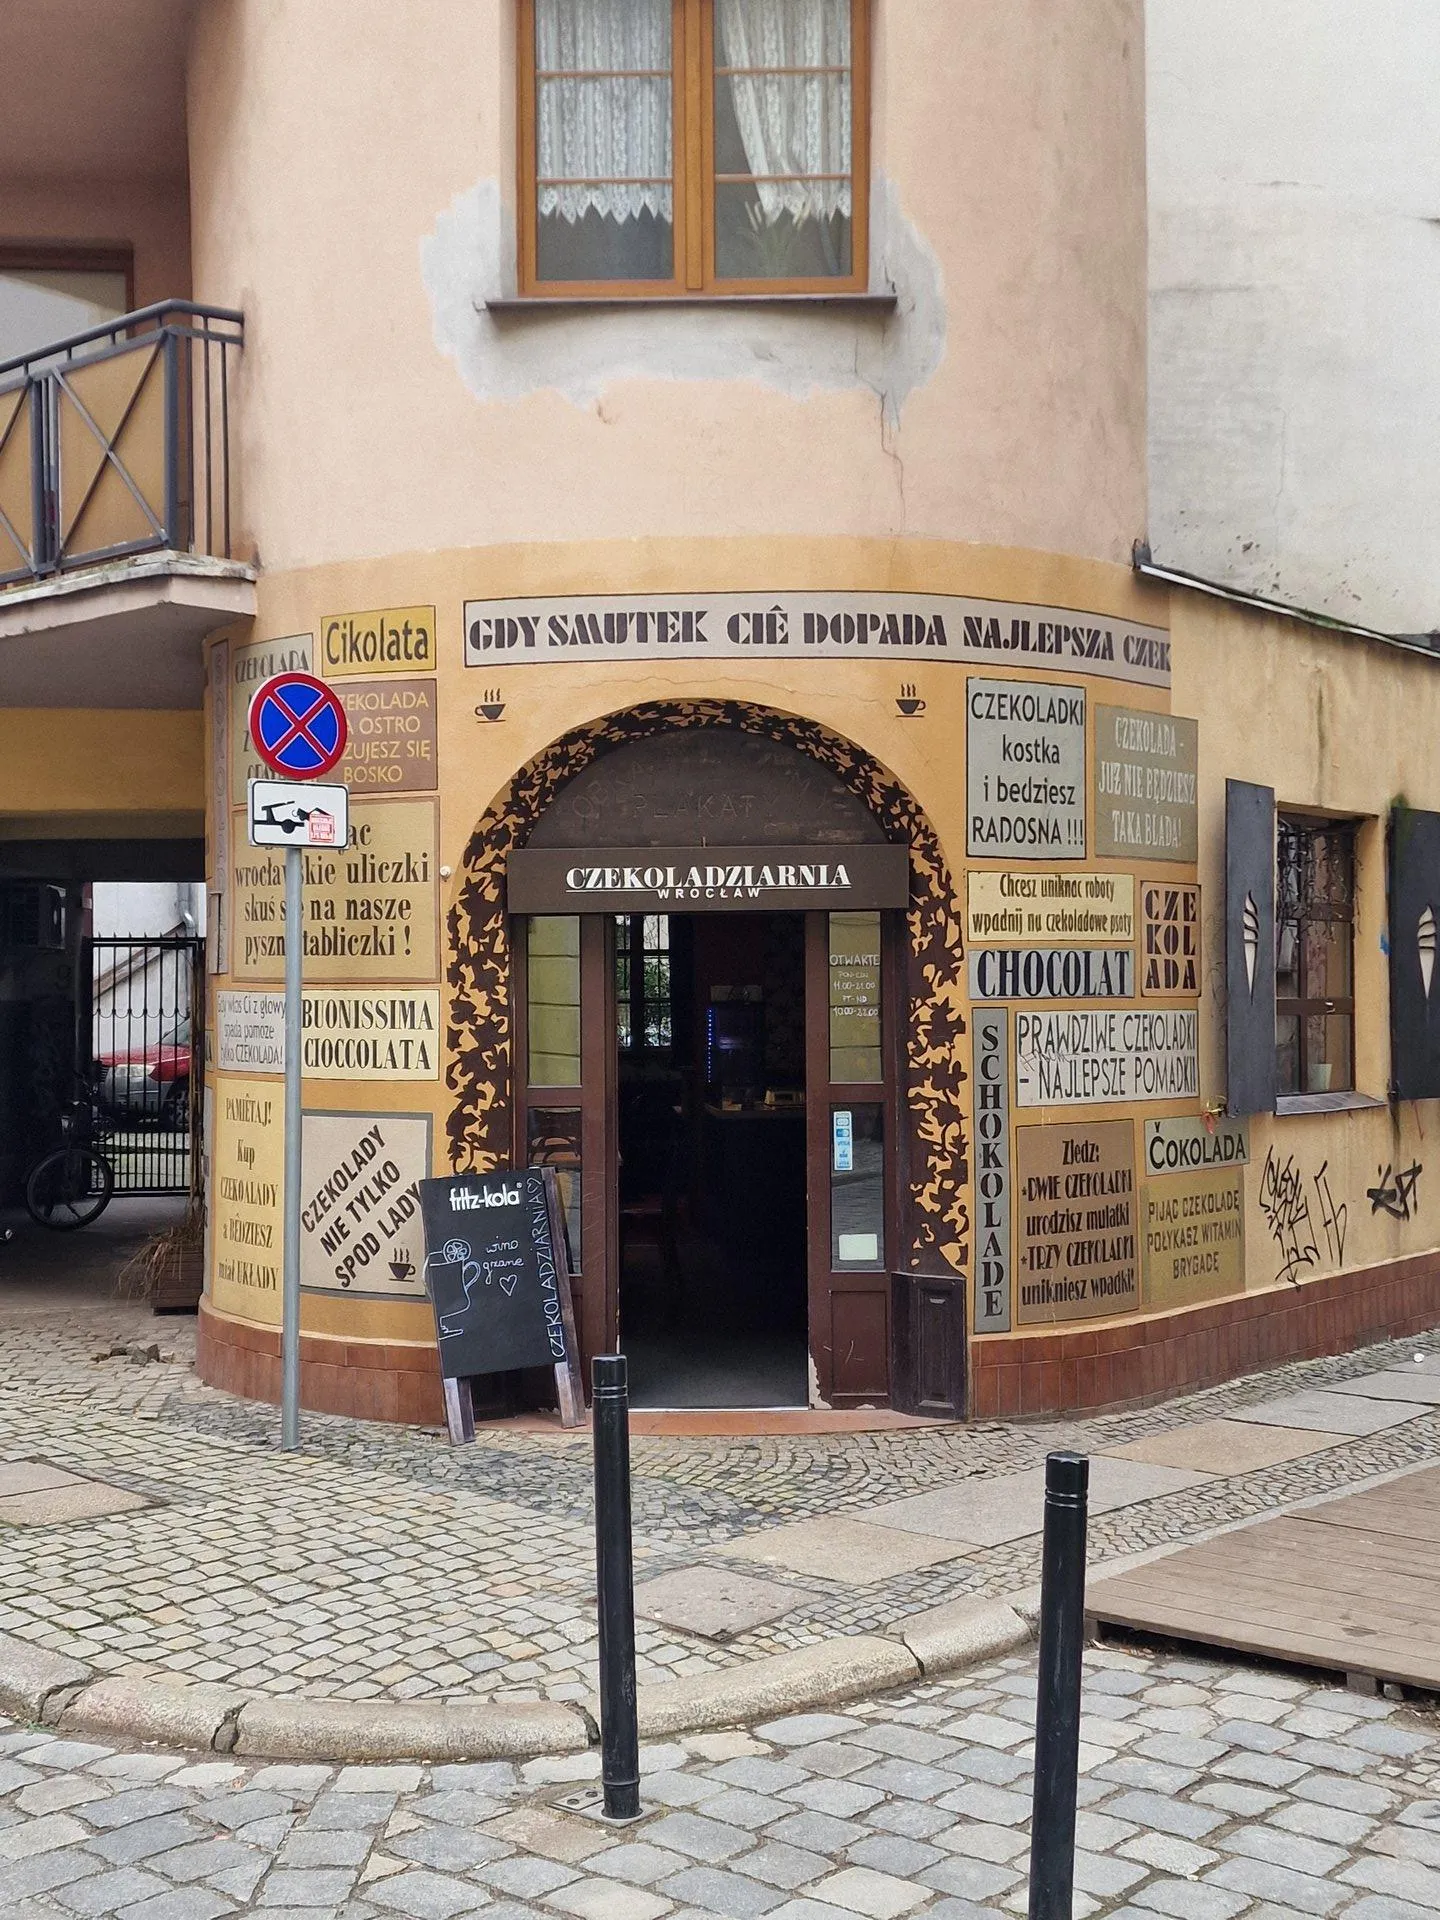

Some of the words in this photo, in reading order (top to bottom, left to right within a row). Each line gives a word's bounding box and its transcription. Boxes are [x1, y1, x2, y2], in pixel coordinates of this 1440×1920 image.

[326, 619, 429, 664] Cikolata
[470, 617, 540, 650] GDY
[548, 611, 708, 646] SMUTEK
[803, 613, 947, 646] DOPADA
[963, 616, 1114, 661] NAJLEPSZA
[1123, 635, 1171, 672] CZEK
[971, 692, 1084, 726] CZEKOLADKI
[359, 716, 420, 735] OSTRO
[1115, 717, 1176, 757] CZEKOLADA
[342, 741, 401, 764] ZUJESZ
[406, 740, 431, 761] SIĘ
[1002, 734, 1061, 765] kostka
[343, 765, 403, 783] BOSKO
[983, 775, 989, 802] i
[1124, 763, 1143, 798] NIE
[1146, 768, 1196, 804] BĘDZIESZ
[972, 816, 1062, 844] RADOSNA
[1112, 810, 1142, 844] TAKA
[346, 852, 429, 884] uliczki
[566, 864, 851, 889] CZEKOLADZIARNIA
[657, 887, 761, 900] WROCŁAW
[1000, 873, 1037, 898] Chcesz
[1085, 876, 1115, 903] roboty
[244, 893, 276, 922] skuś
[310, 898, 336, 921] na
[346, 898, 412, 921] nasze
[1145, 890, 1196, 921] CZE
[972, 908, 1023, 935] wpadnij
[1046, 908, 1108, 932] czekoladowe
[245, 935, 287, 965] pyszn
[303, 926, 395, 956] tabliczki
[1146, 924, 1195, 955] KOL
[830, 954, 880, 966] OTWARTE
[977, 950, 1130, 997] CHOCOLAT
[1145, 959, 1196, 990] ADA
[302, 999, 434, 1030] BUONISSIMA
[1018, 1014, 1116, 1054] PRAWDZIWE
[1122, 1014, 1195, 1052] CZEKOLADKI
[304, 1038, 432, 1069] CIOCCOLATA
[1039, 1058, 1126, 1099] NAJLEPSZE
[237, 1139, 255, 1169] Kup
[1149, 1121, 1247, 1170] ČOKOLADA
[301, 1125, 386, 1233] CZEKOLADY
[978, 1025, 1004, 1318] SCHOKOLADE
[1065, 1169, 1132, 1199] CZEKOLADKI
[320, 1216, 351, 1257] NIE
[345, 1160, 401, 1223] TYLKO
[1026, 1208, 1083, 1236] urodzisz
[1086, 1201, 1129, 1231] mulatki
[1148, 1199, 1178, 1223] PIJĄC
[1182, 1190, 1240, 1218] CZEKOLADĘ
[335, 1232, 380, 1288] SPOD
[377, 1182, 421, 1239] LADY
[486, 1235, 519, 1254] wino
[1147, 1226, 1199, 1253] POŁYKASZ
[1202, 1219, 1242, 1243] WITAMIN
[1066, 1235, 1134, 1267] CZEKOLADKI
[1173, 1251, 1219, 1280] BRYGADĘ
[1022, 1276, 1088, 1306] unikniesz
[1090, 1268, 1135, 1298] wpadki!
